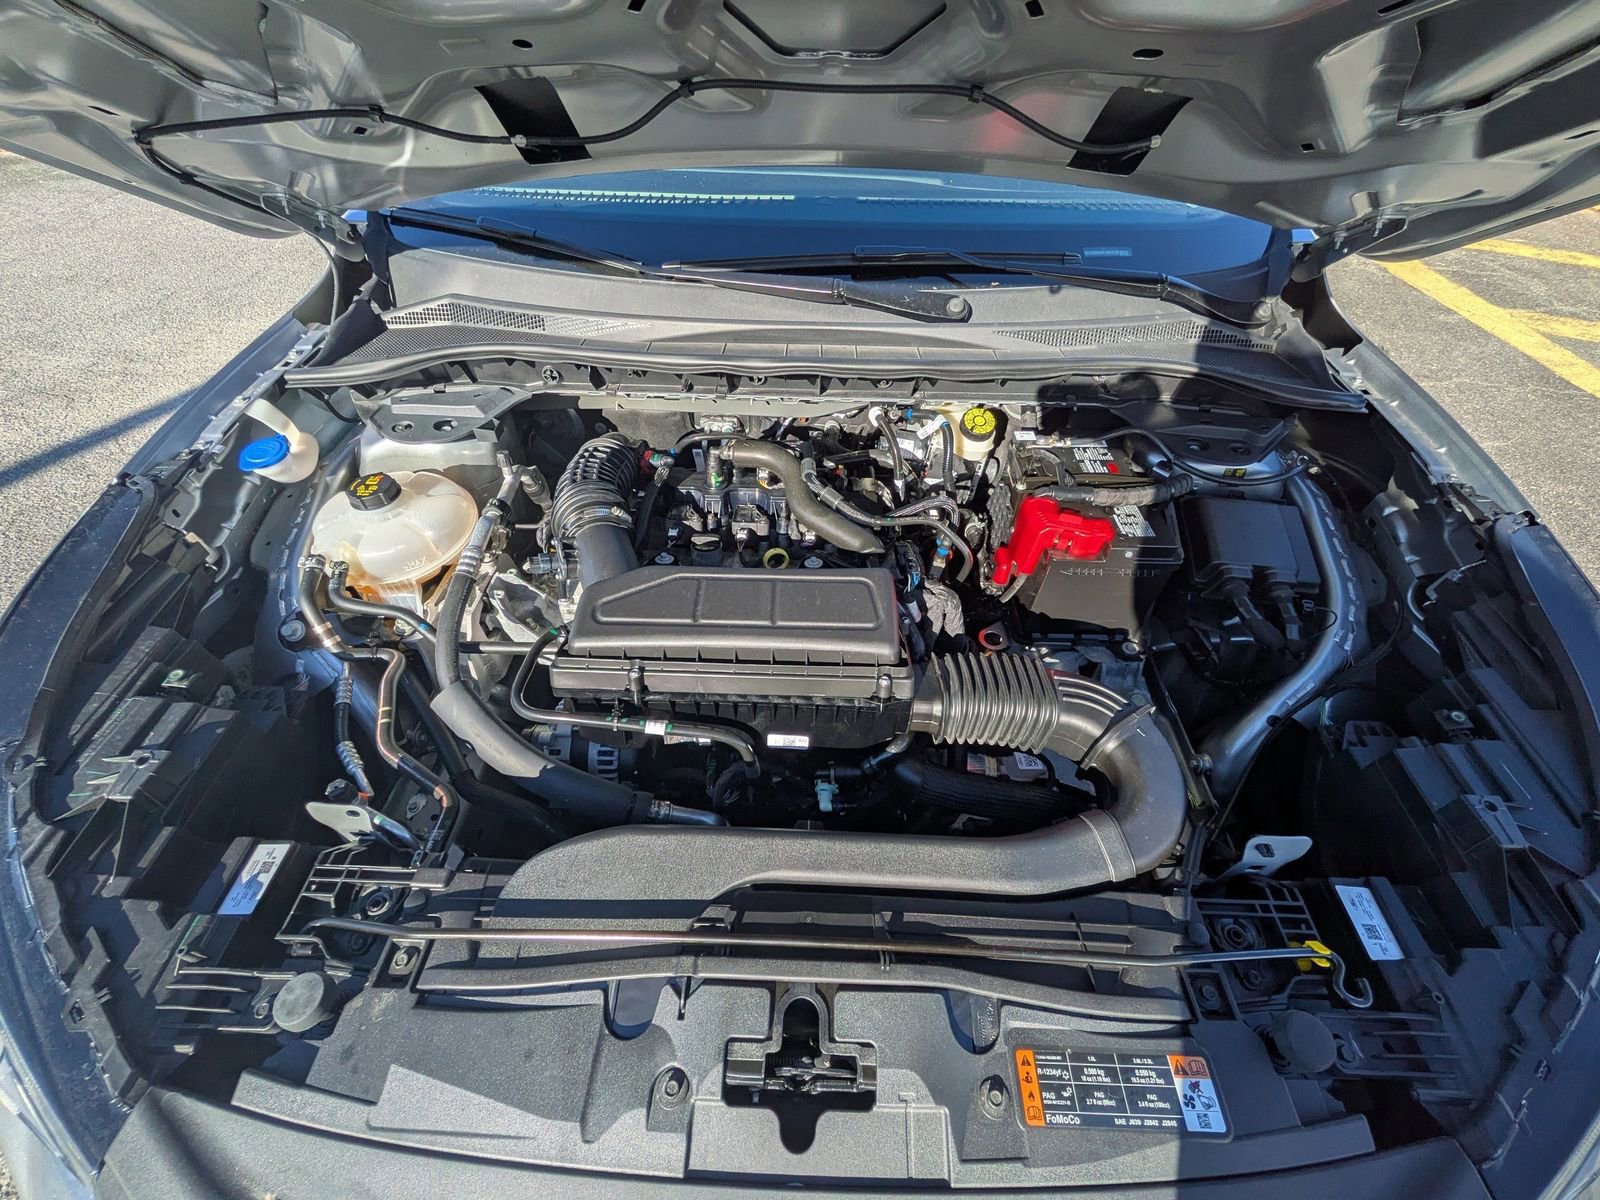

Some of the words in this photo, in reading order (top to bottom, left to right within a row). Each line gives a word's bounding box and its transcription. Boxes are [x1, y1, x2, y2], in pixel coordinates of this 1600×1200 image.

[1037, 1068, 1062, 1077] R-1234yf
[1148, 1069, 1156, 1078] kg
[1042, 1092, 1056, 1100] PAG
[1046, 1114, 1080, 1124] FoMoCo
